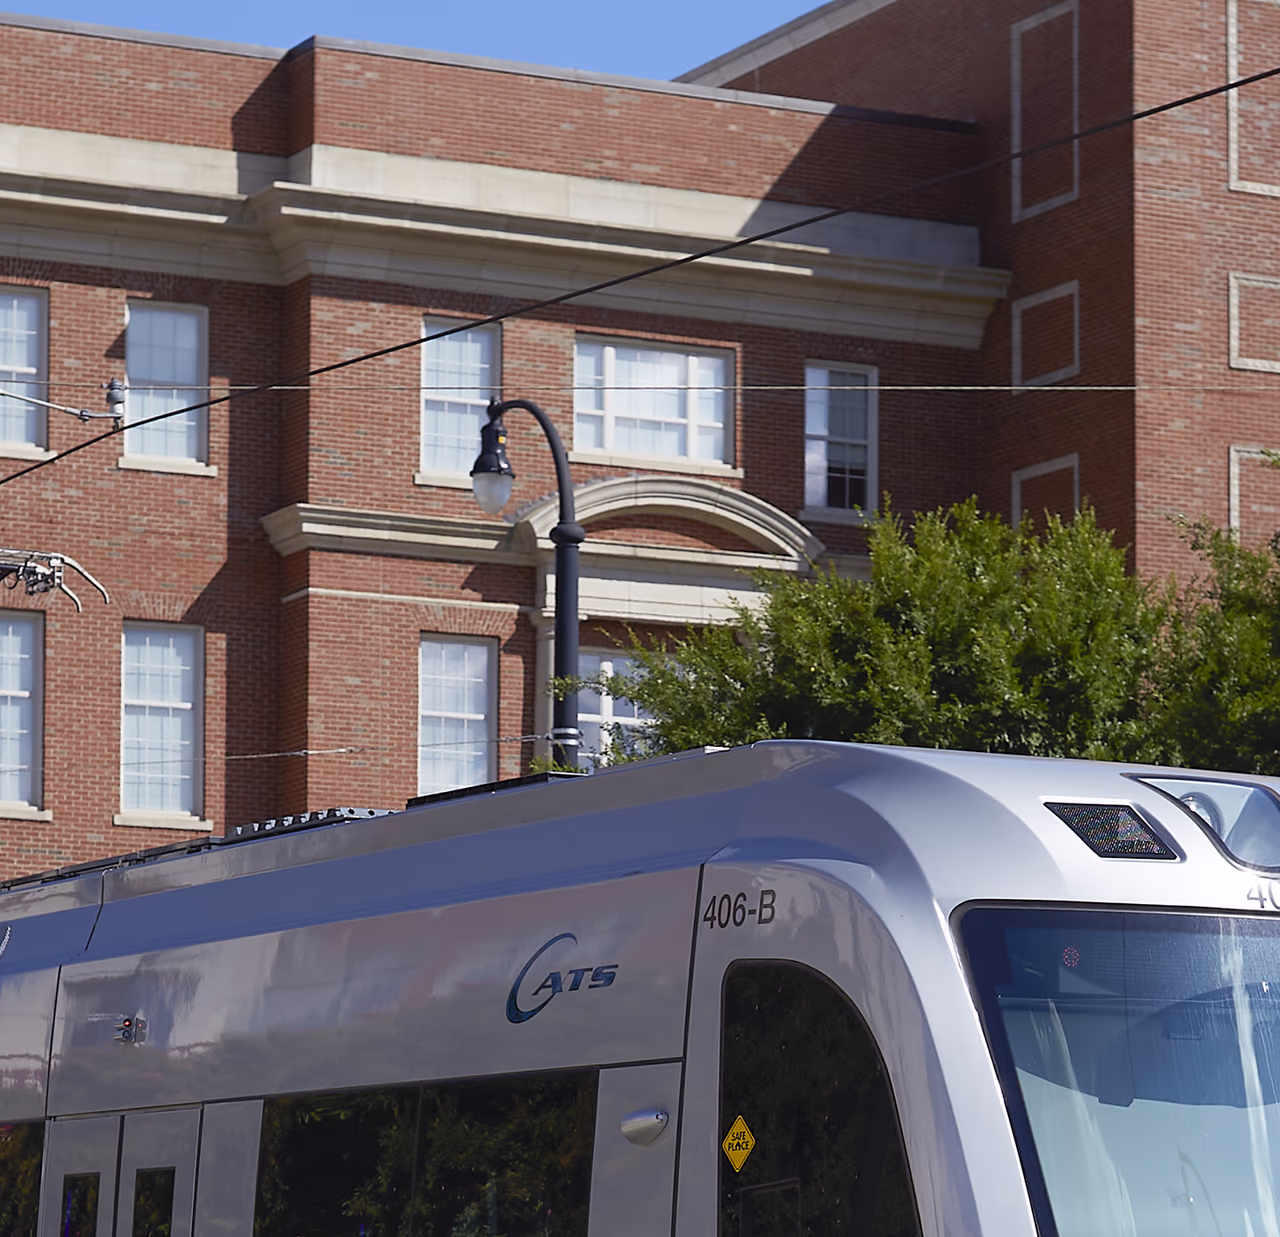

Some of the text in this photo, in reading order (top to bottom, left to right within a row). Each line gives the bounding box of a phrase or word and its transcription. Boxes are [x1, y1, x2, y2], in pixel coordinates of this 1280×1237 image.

[703, 889, 776, 929] 406-B
[506, 933, 618, 1023] CATS
[728, 1141, 749, 1151] PLACE
[731, 1131, 746, 1141] SAFE
